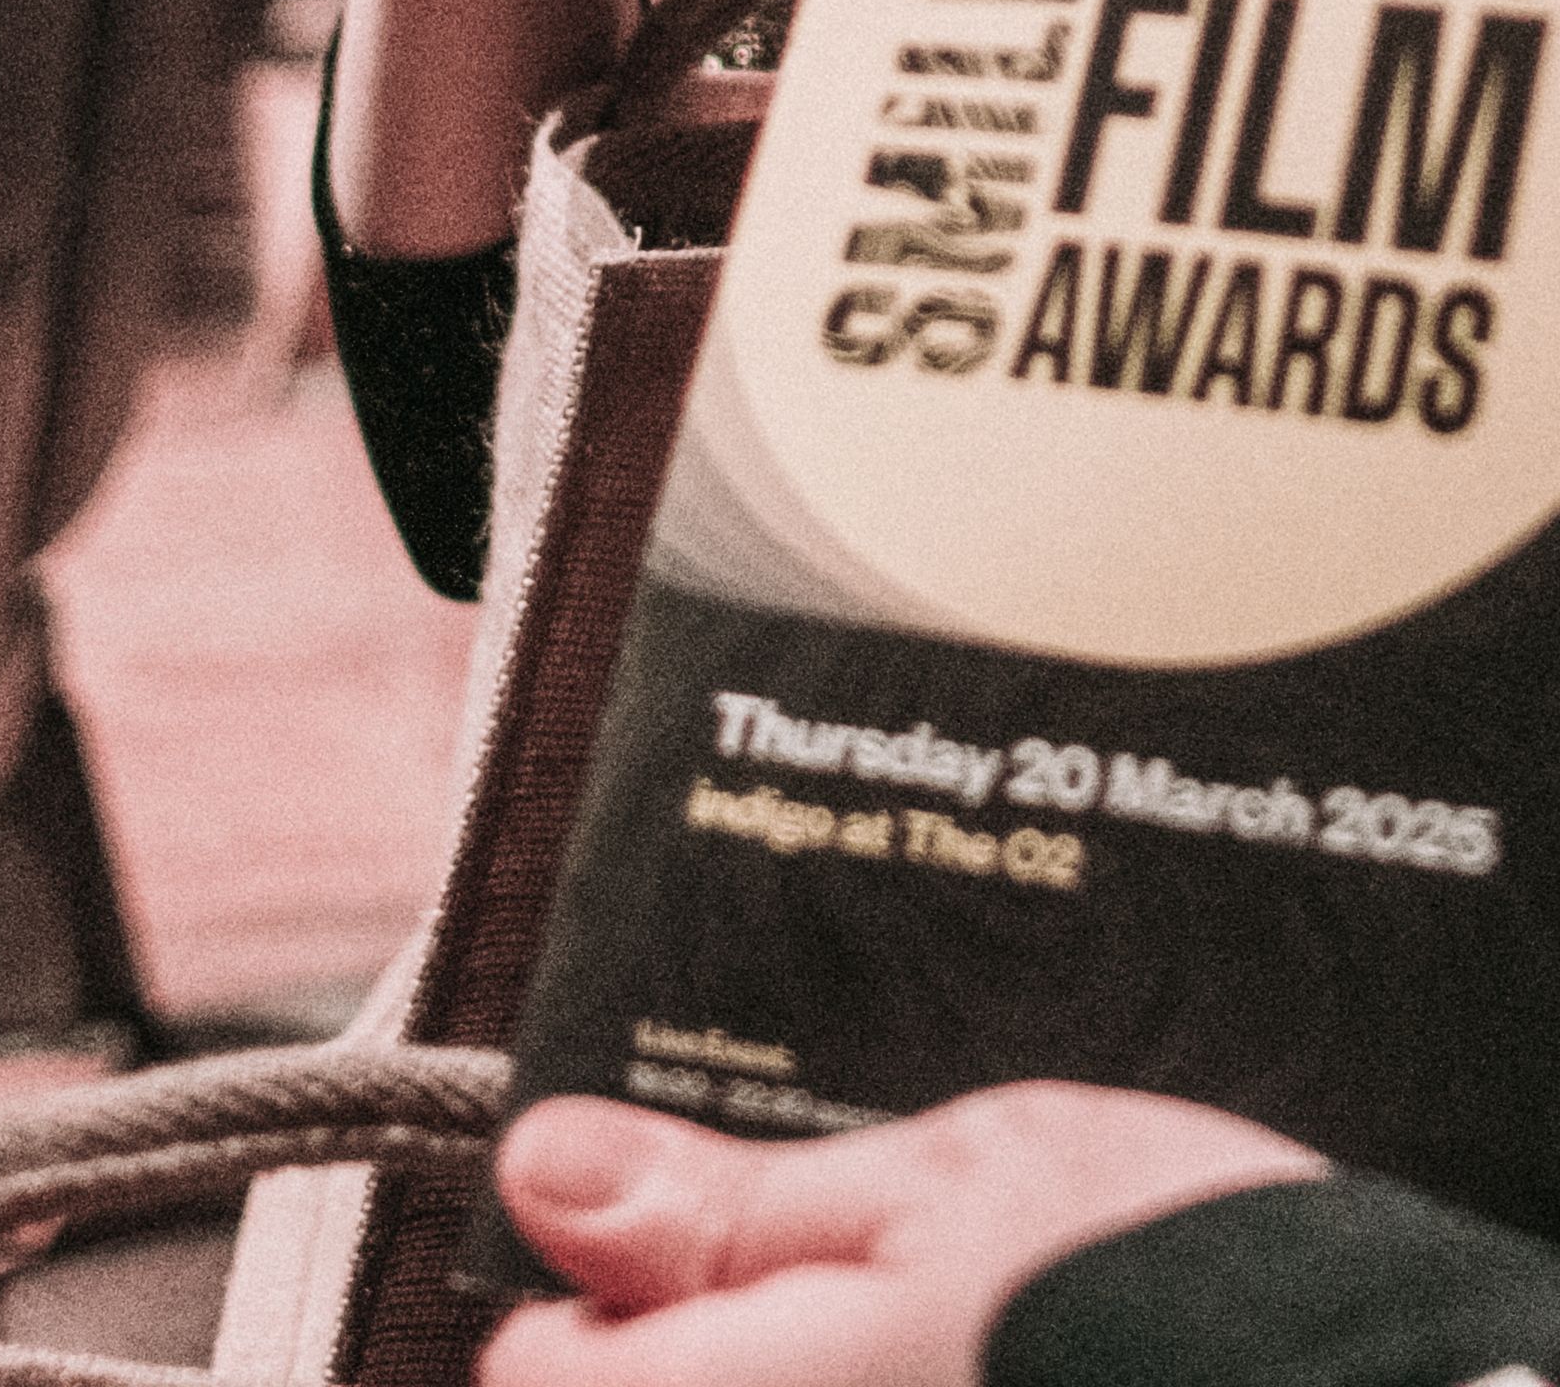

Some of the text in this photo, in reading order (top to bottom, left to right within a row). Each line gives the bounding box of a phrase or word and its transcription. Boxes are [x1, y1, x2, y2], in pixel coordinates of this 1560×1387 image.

[1009, 240, 1498, 434] AWARDS
[710, 691, 1500, 878] Thursday 20 March 2025
[903, 809, 998, 875] The
[1002, 829, 1086, 891] O2
